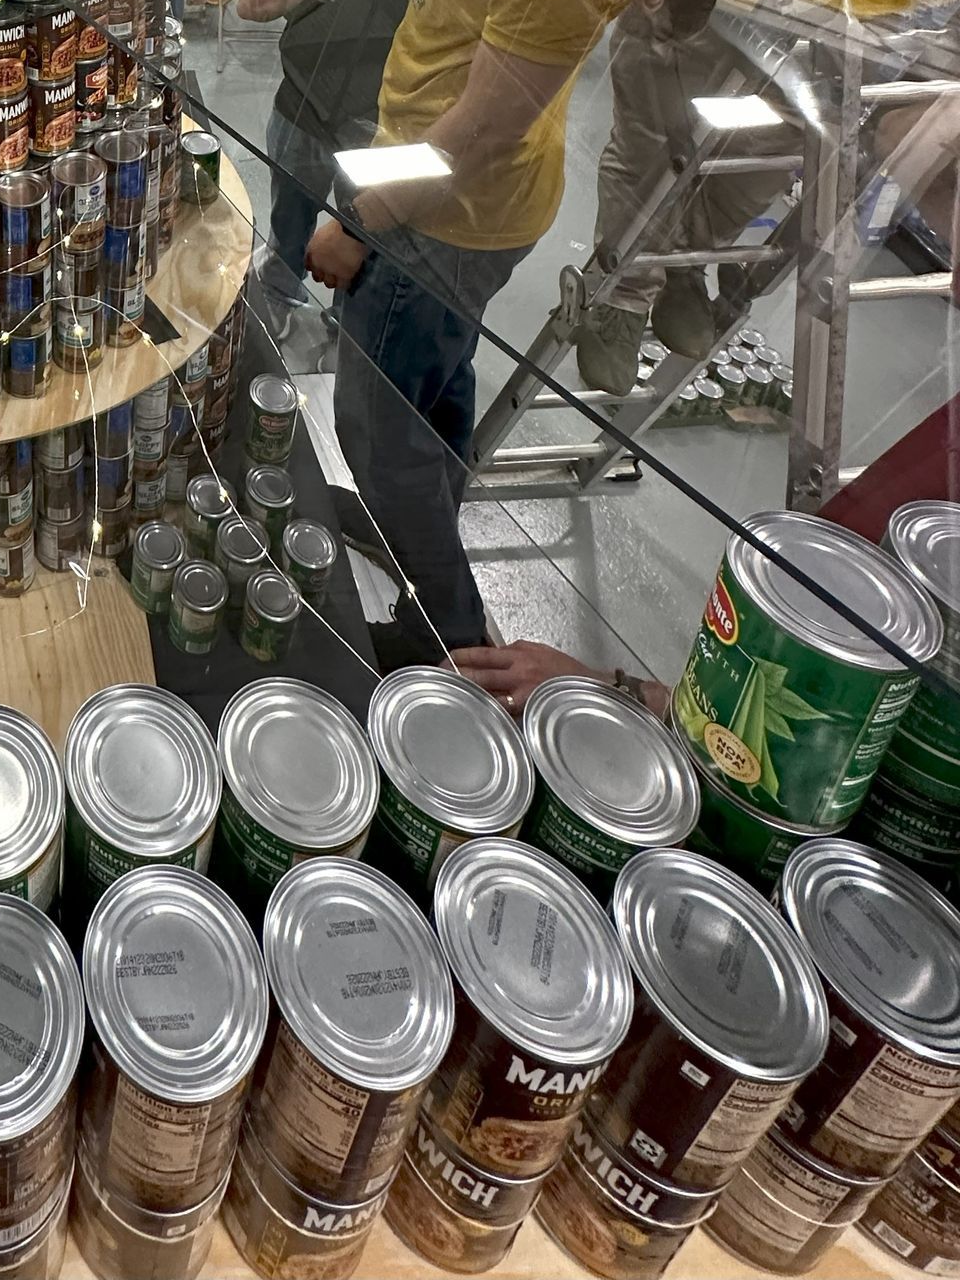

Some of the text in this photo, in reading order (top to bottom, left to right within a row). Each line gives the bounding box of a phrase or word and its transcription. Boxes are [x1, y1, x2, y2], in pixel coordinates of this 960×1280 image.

[45, 80, 76, 104] MANW
[0, 96, 28, 122] MANW
[698, 632, 714, 663] Cut
[709, 638, 740, 682] WITH
[717, 737, 746, 765] NON
[396, 802, 437, 838] Facts
[870, 793, 951, 838] Nutrition
[547, 804, 619, 858] Nutrition
[252, 833, 289, 861] Facts
[407, 841, 430, 860] 20
[282, 1024, 368, 1099] Nutrition Facts
[886, 1046, 951, 1077] Nutrition
[871, 1067, 925, 1096] Calories
[177, 1106, 210, 1114] Facts
[341, 1107, 361, 1117] 40
[418, 1122, 500, 1208] WICH
[573, 1119, 659, 1214] WICH
[812, 1171, 850, 1192] Facts
